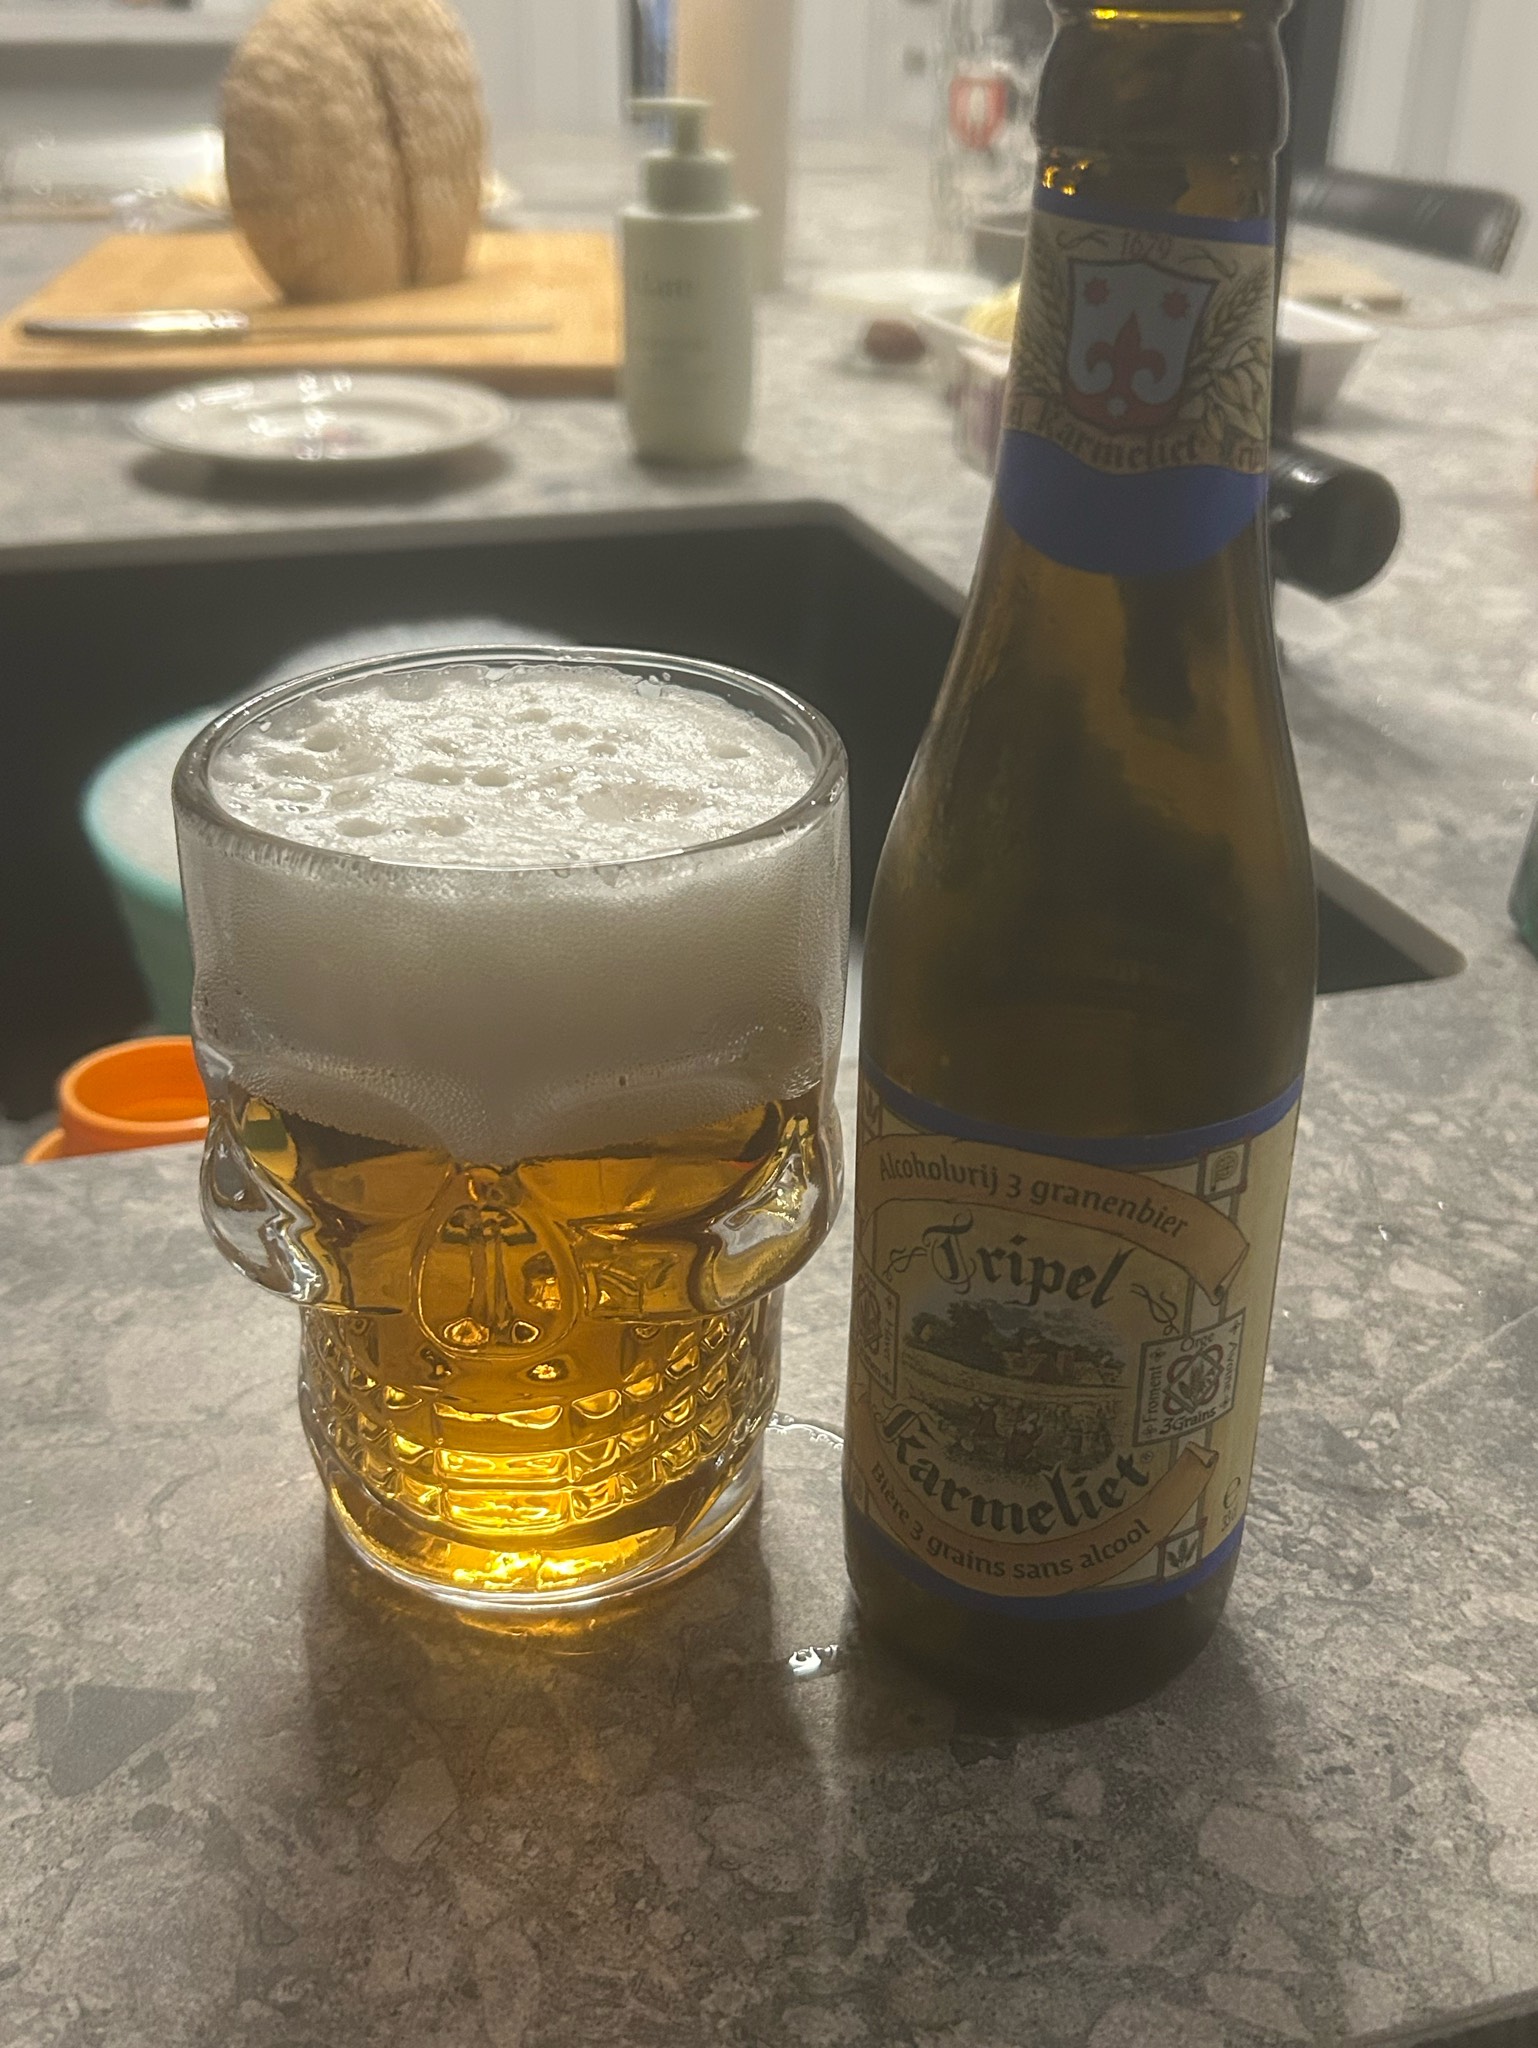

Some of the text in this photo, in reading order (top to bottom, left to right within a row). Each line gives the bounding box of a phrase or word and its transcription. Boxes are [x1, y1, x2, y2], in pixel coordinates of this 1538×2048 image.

[879, 1153, 1189, 1239] Alcoholvrij 3 granenbier
[922, 1208, 1137, 1309] Tripel
[1142, 1365, 1163, 1423] Froment
[873, 1403, 1150, 1536] Karmeliet
[909, 1522, 925, 1542] 3
[926, 1534, 1006, 1579] grains
[1012, 1557, 1074, 1580] sans
[1080, 1518, 1152, 1570] alcool
